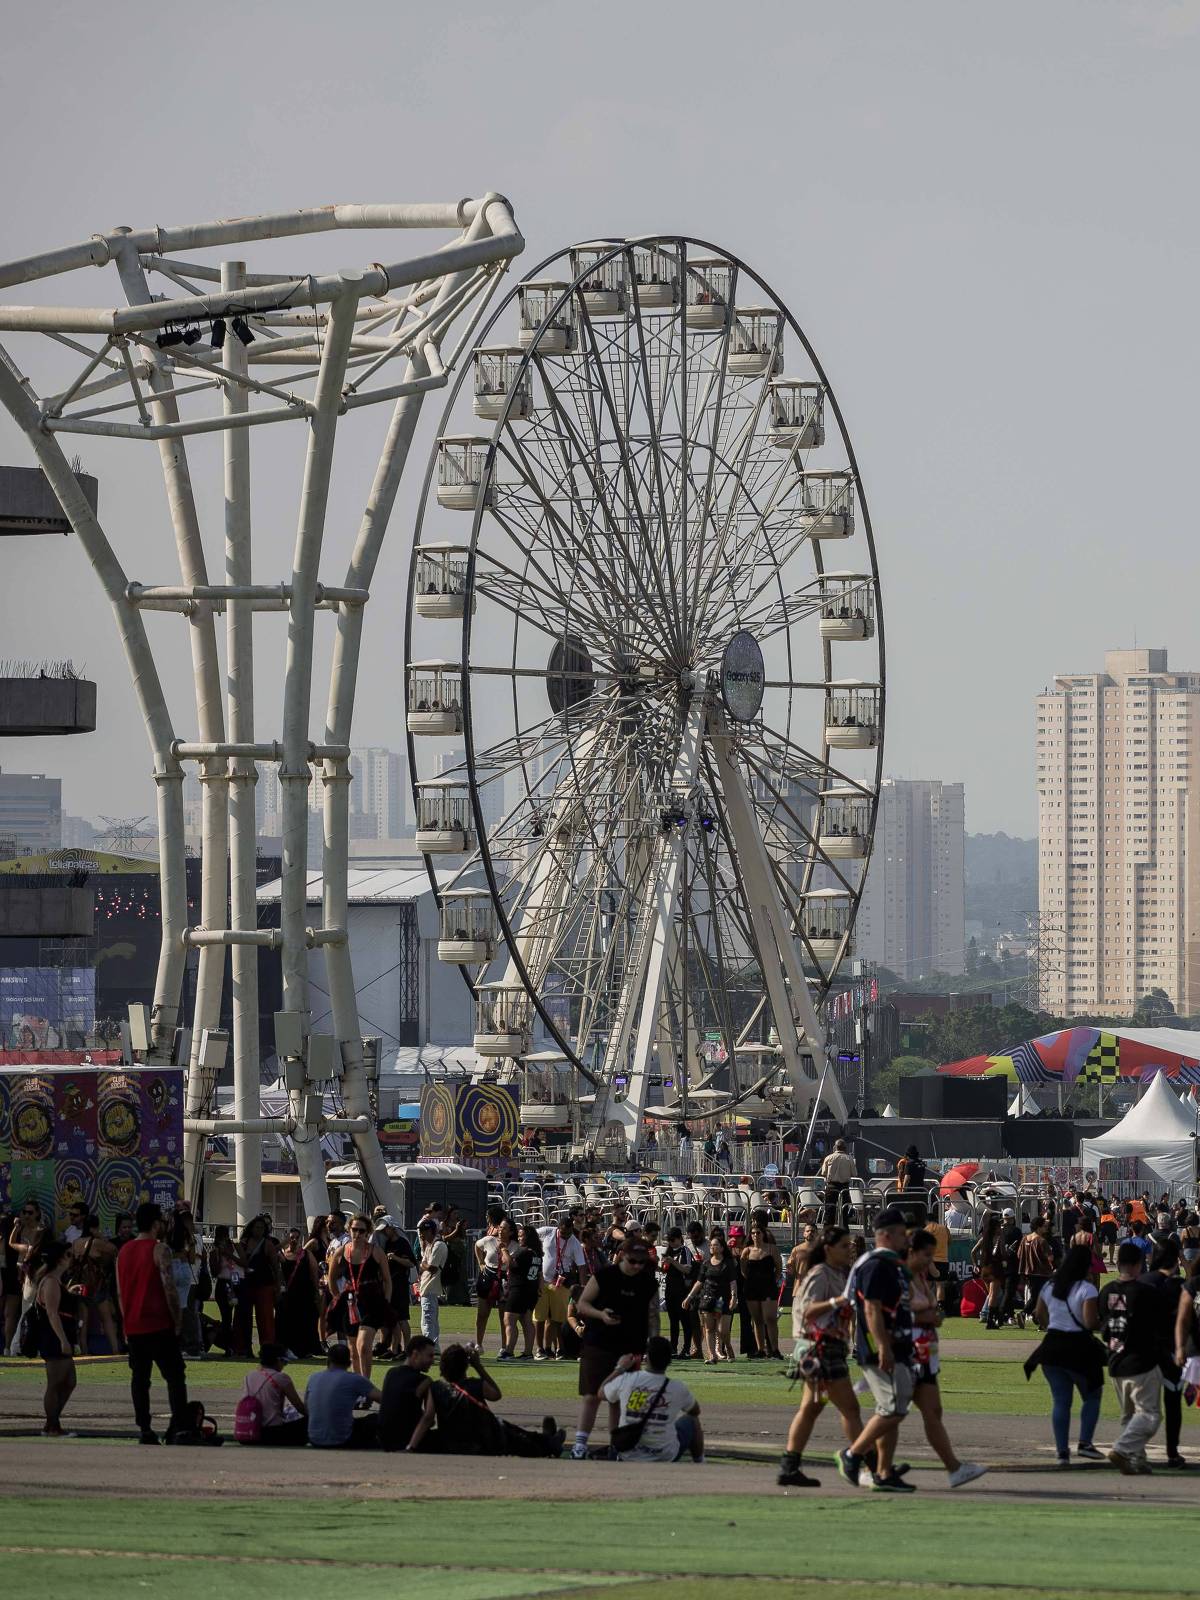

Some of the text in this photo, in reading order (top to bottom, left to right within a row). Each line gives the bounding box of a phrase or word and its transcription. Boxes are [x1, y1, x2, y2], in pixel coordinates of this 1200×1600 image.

[727, 670, 750, 685] Galaxy
[0, 976, 28, 984] AMSUNG
[26, 1077, 39, 1085] CLUB
[112, 1075, 127, 1083] CLUB
